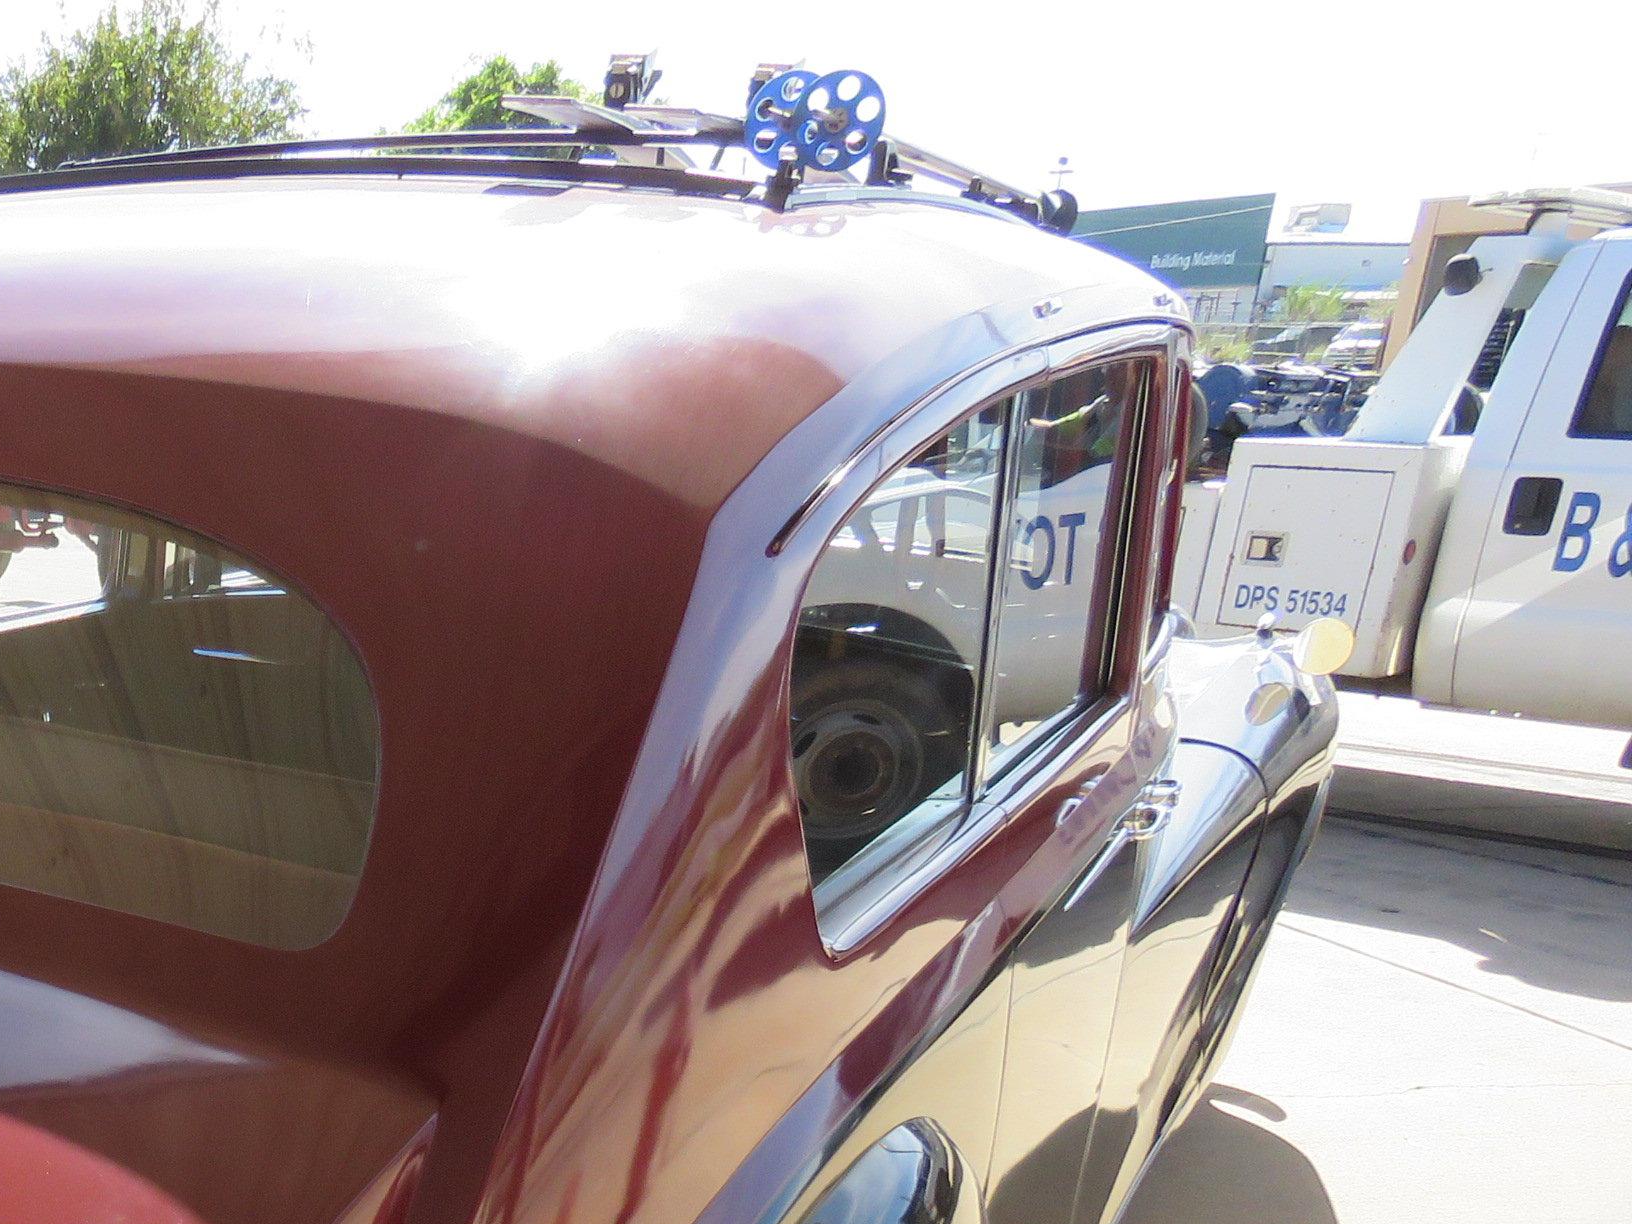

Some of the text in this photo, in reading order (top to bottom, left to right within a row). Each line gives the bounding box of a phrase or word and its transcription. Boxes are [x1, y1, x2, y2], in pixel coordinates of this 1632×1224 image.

[1151, 249, 1237, 271] Building Material
[1552, 492, 1601, 571] B
[1234, 584, 1348, 617] DPS 51534
